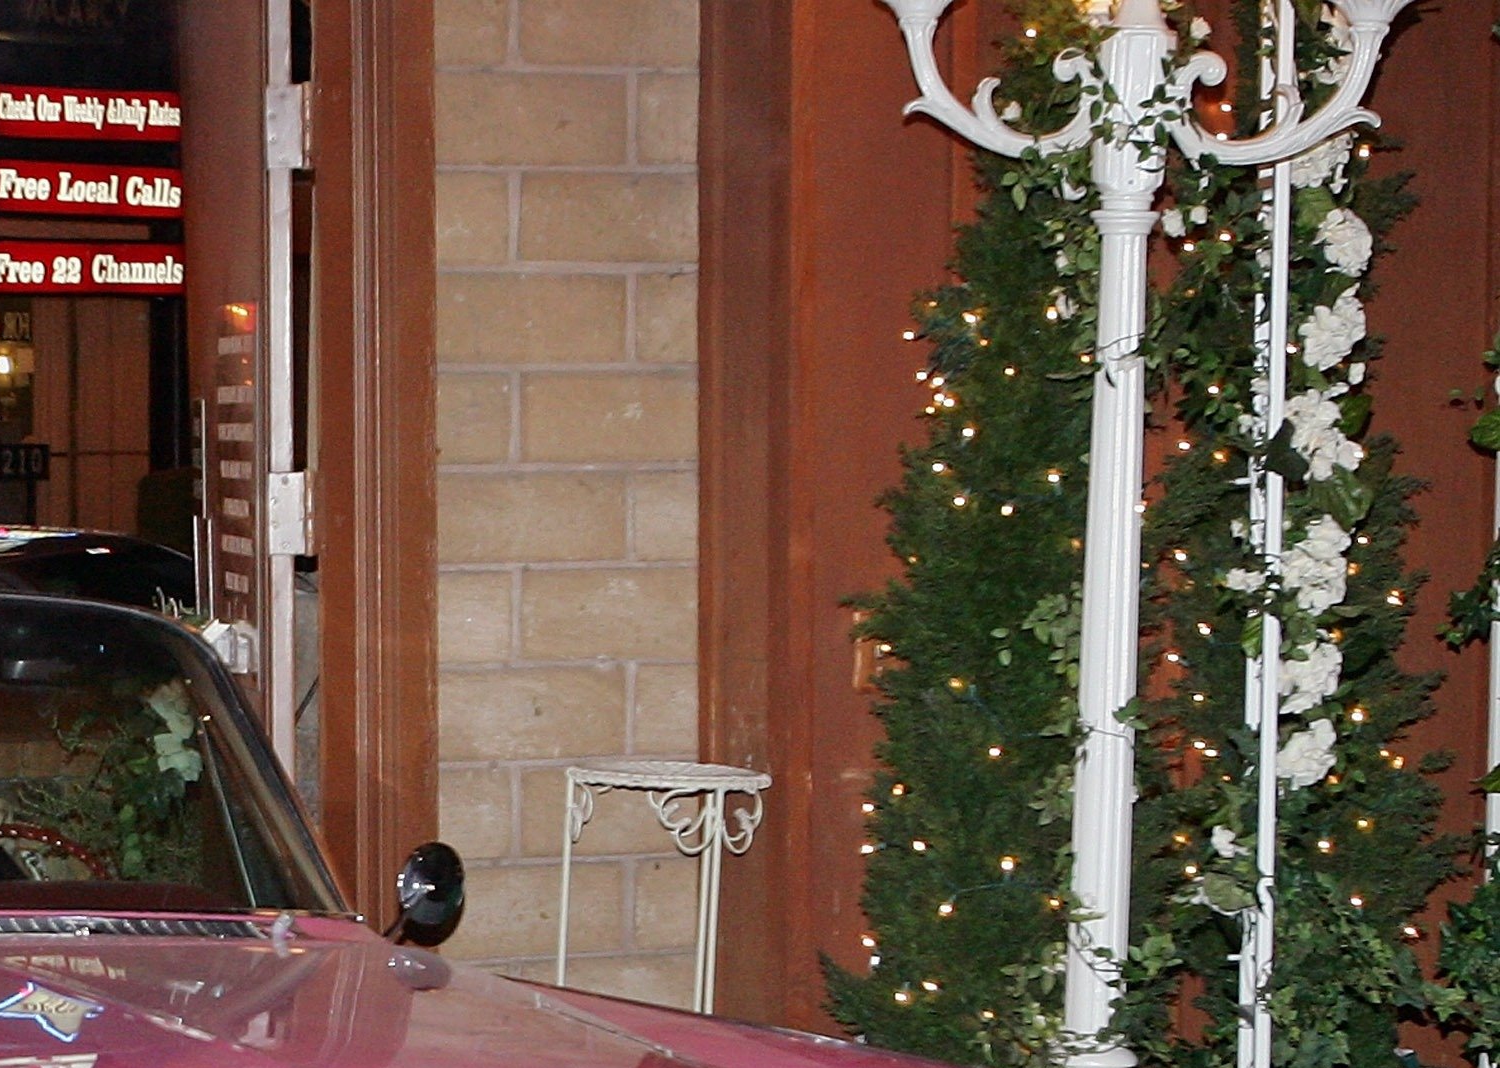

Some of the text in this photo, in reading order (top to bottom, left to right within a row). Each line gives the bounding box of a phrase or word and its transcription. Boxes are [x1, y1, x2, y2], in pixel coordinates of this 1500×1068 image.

[37, 94, 62, 122] Our
[63, 96, 105, 130] Weekly
[148, 99, 181, 127] Rates
[57, 172, 119, 204] Local
[125, 176, 181, 208] Calls
[52, 256, 82, 284] 22
[92, 254, 184, 285] Channels
